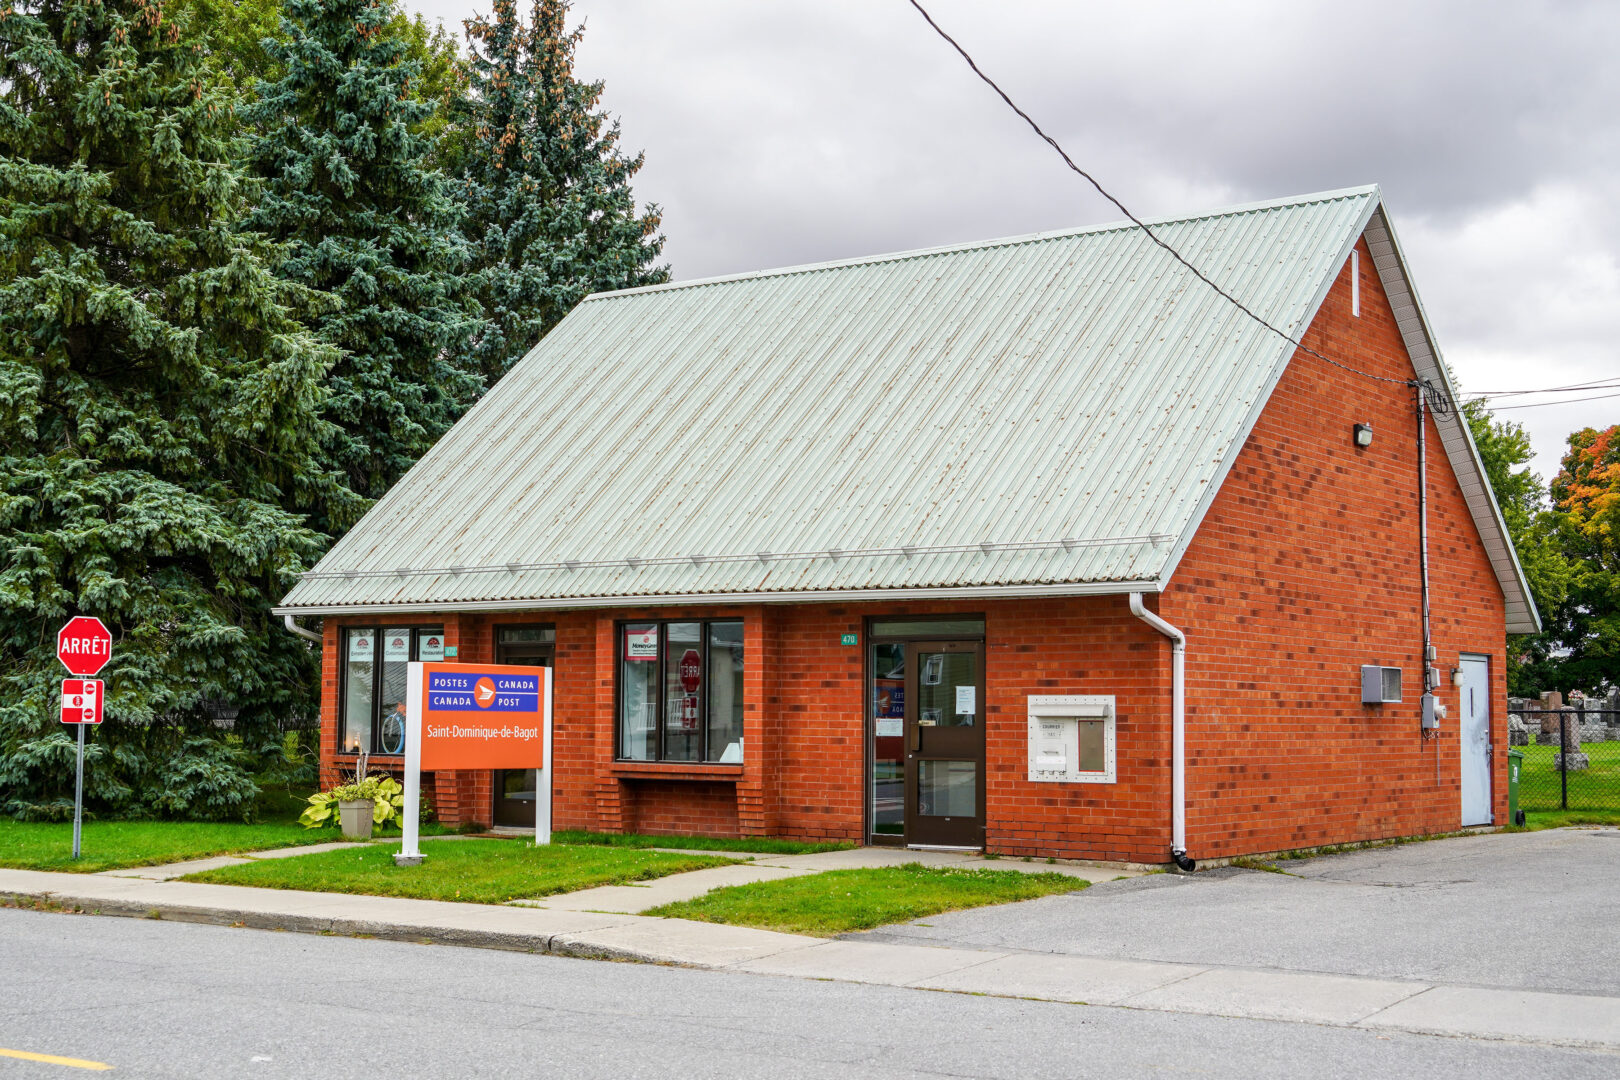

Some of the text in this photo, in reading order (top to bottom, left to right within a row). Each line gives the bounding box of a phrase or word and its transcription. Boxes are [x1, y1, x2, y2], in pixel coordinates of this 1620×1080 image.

[842, 636, 855, 644] 470
[61, 636, 109, 655] ARRÊT
[434, 679, 468, 687] POSTES
[498, 681, 534, 689] CANADA
[433, 697, 471, 706] CANADA
[498, 698, 520, 706] POST
[427, 724, 538, 741] Saint-Dominique-de-Bagot
